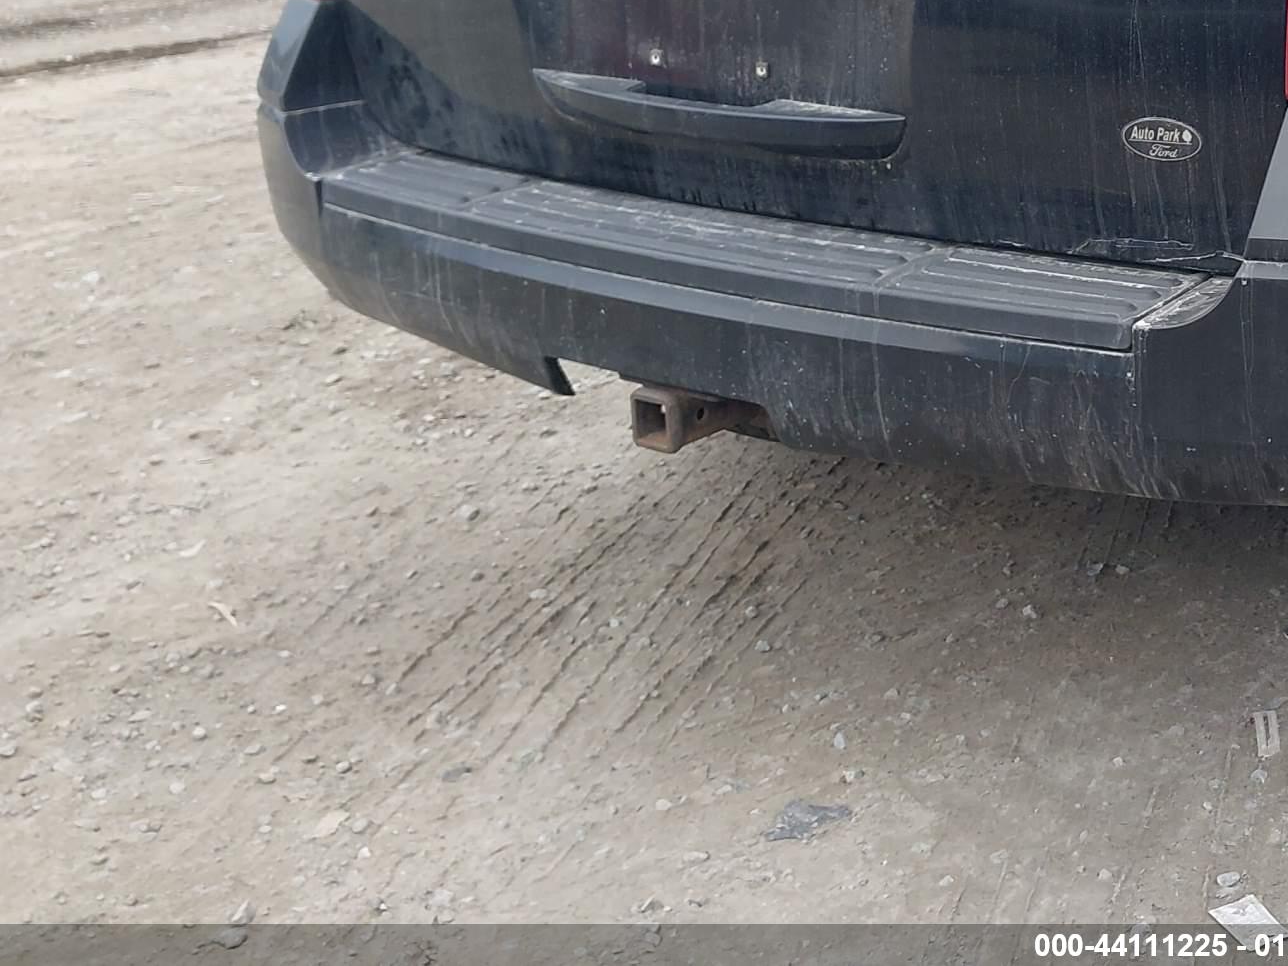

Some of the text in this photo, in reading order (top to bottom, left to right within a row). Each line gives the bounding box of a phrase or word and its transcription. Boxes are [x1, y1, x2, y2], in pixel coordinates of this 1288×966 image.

[1130, 125, 1181, 143] Auto Park
[1148, 143, 1178, 158] Ford
